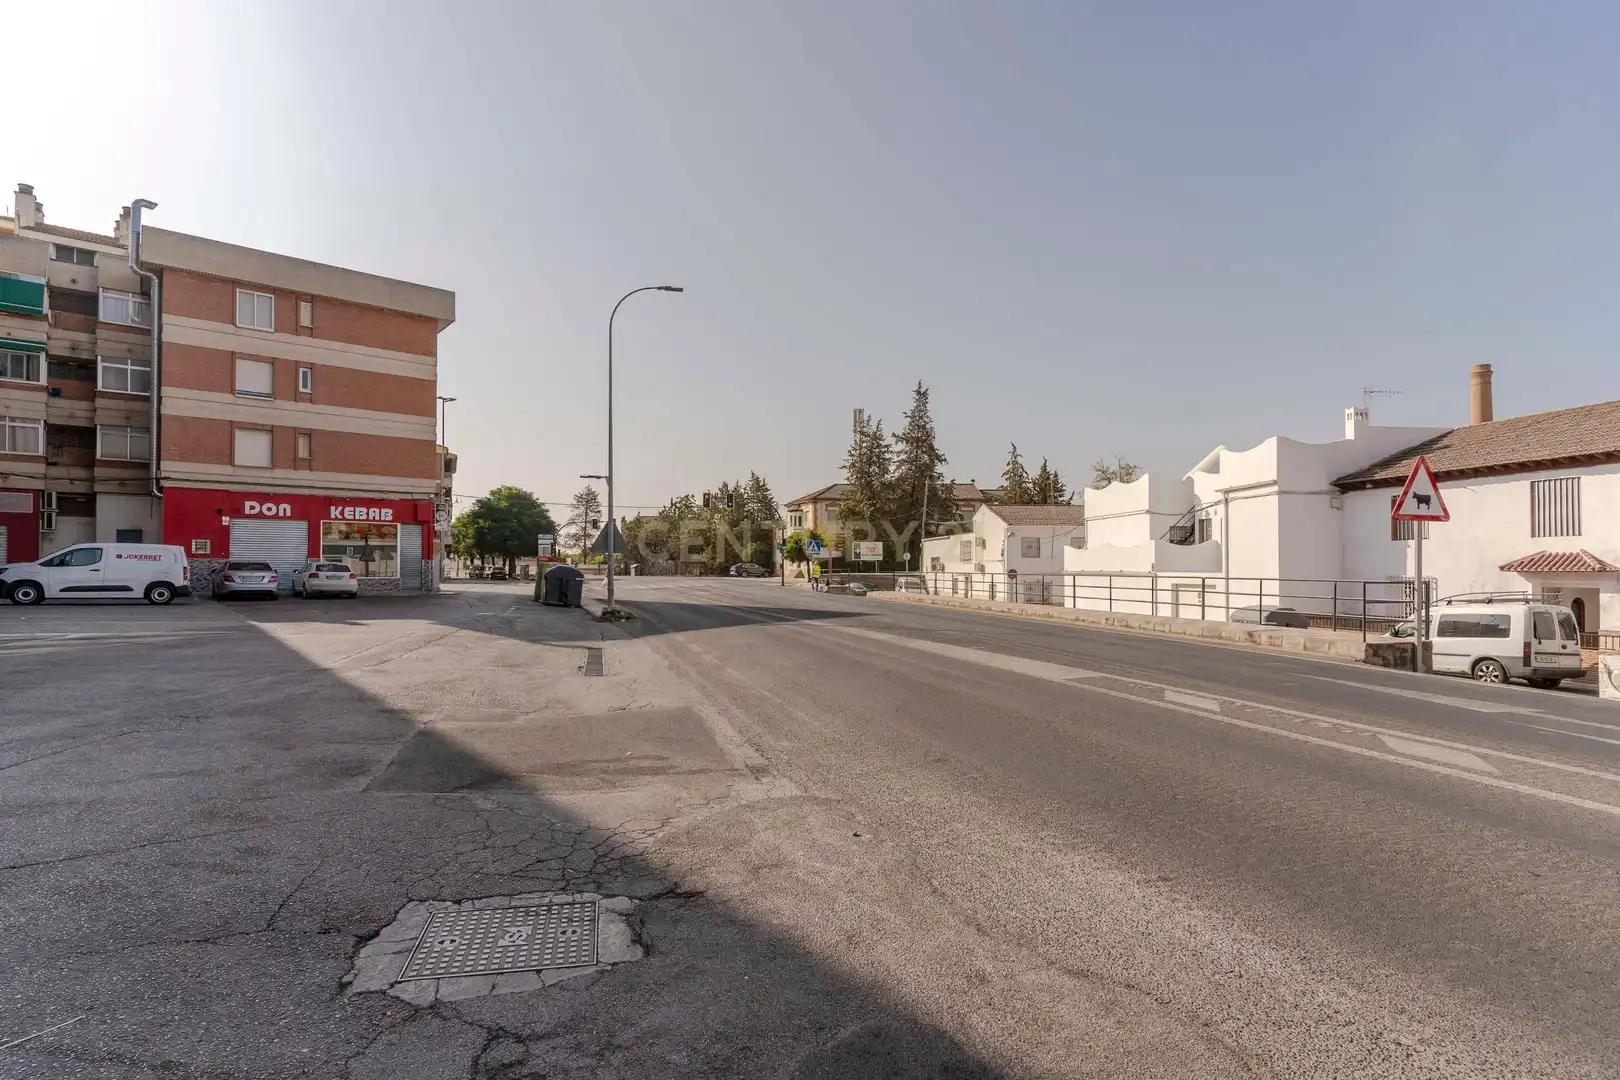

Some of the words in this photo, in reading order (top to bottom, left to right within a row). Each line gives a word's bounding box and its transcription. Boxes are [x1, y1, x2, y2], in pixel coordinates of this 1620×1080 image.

[244, 500, 291, 517] DON
[330, 505, 393, 521] KEBAB
[123, 553, 164, 561] JOKERBET
